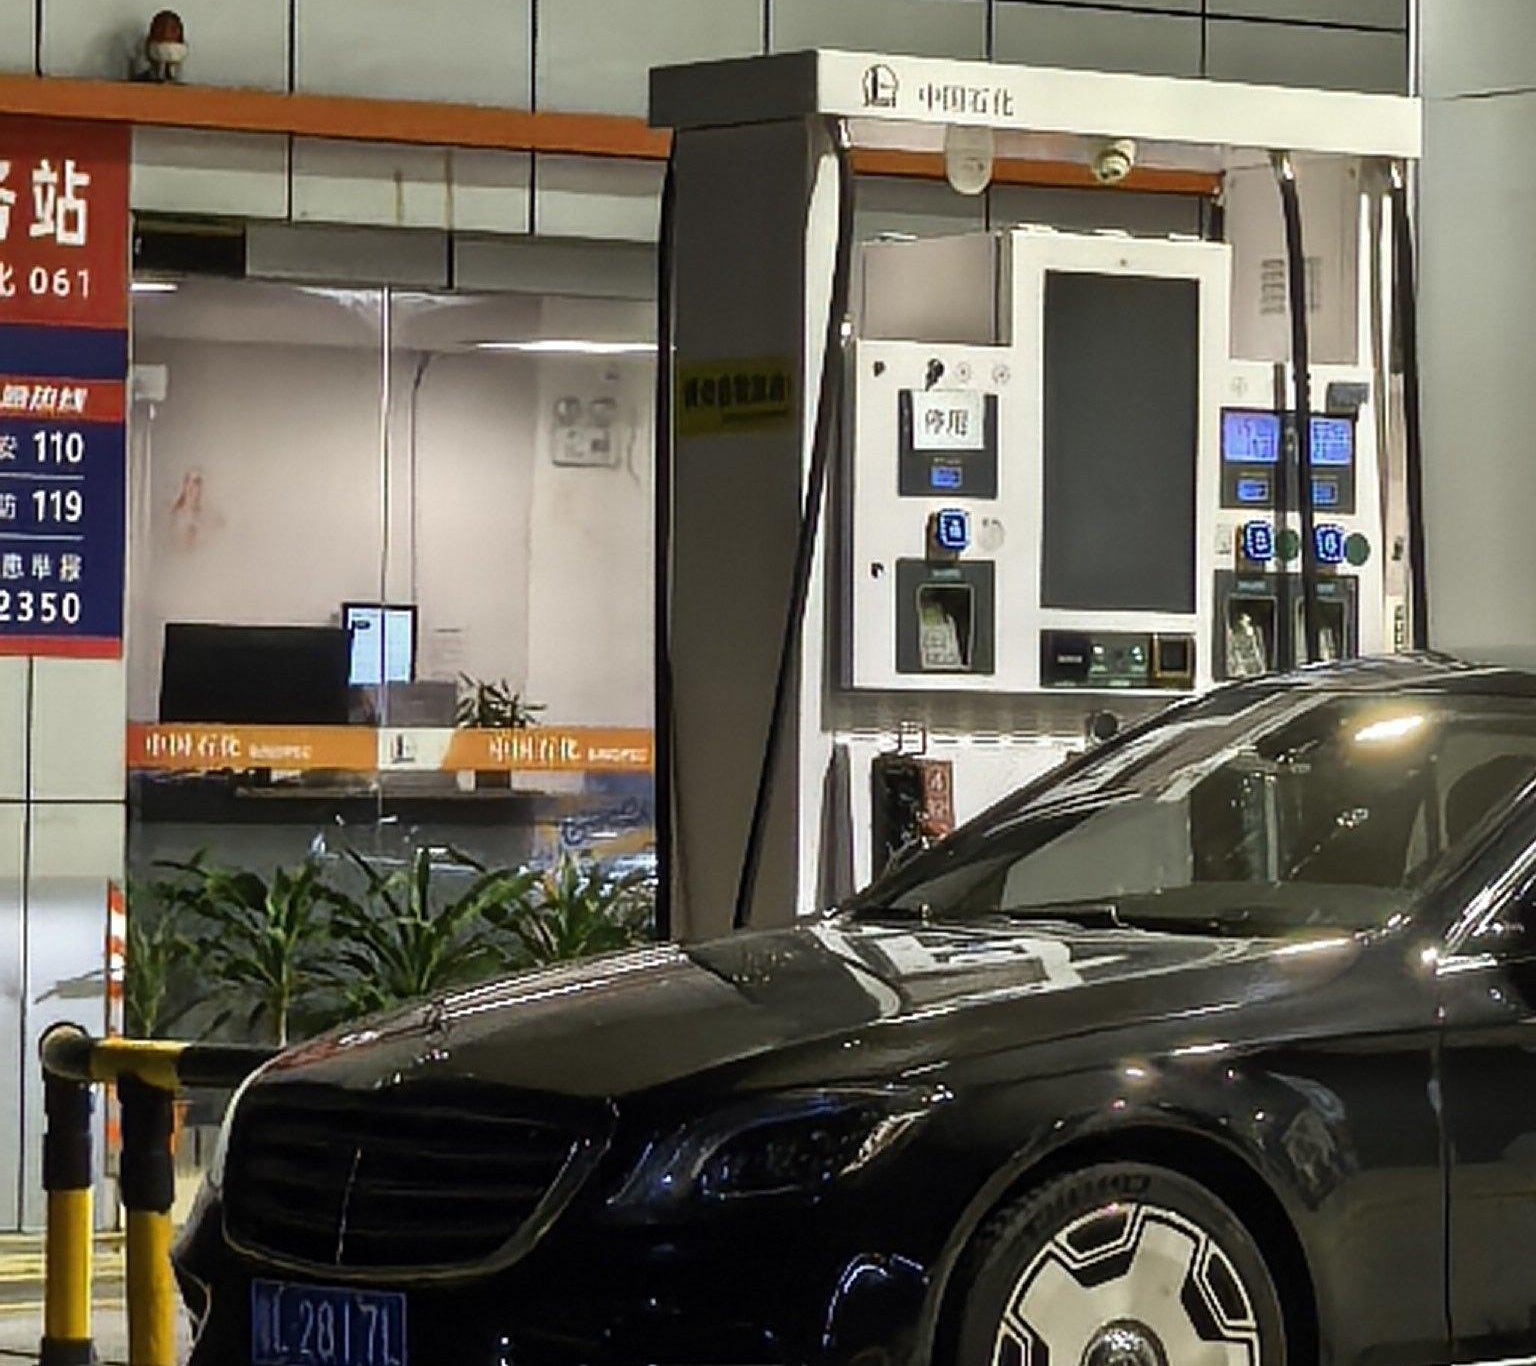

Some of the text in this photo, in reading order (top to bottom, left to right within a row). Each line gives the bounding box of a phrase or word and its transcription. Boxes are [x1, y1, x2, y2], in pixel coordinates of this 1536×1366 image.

[919, 83, 1014, 116] 中国石化
[29, 266, 90, 300] 061
[33, 431, 83, 463] 110
[32, 490, 82, 522] 119
